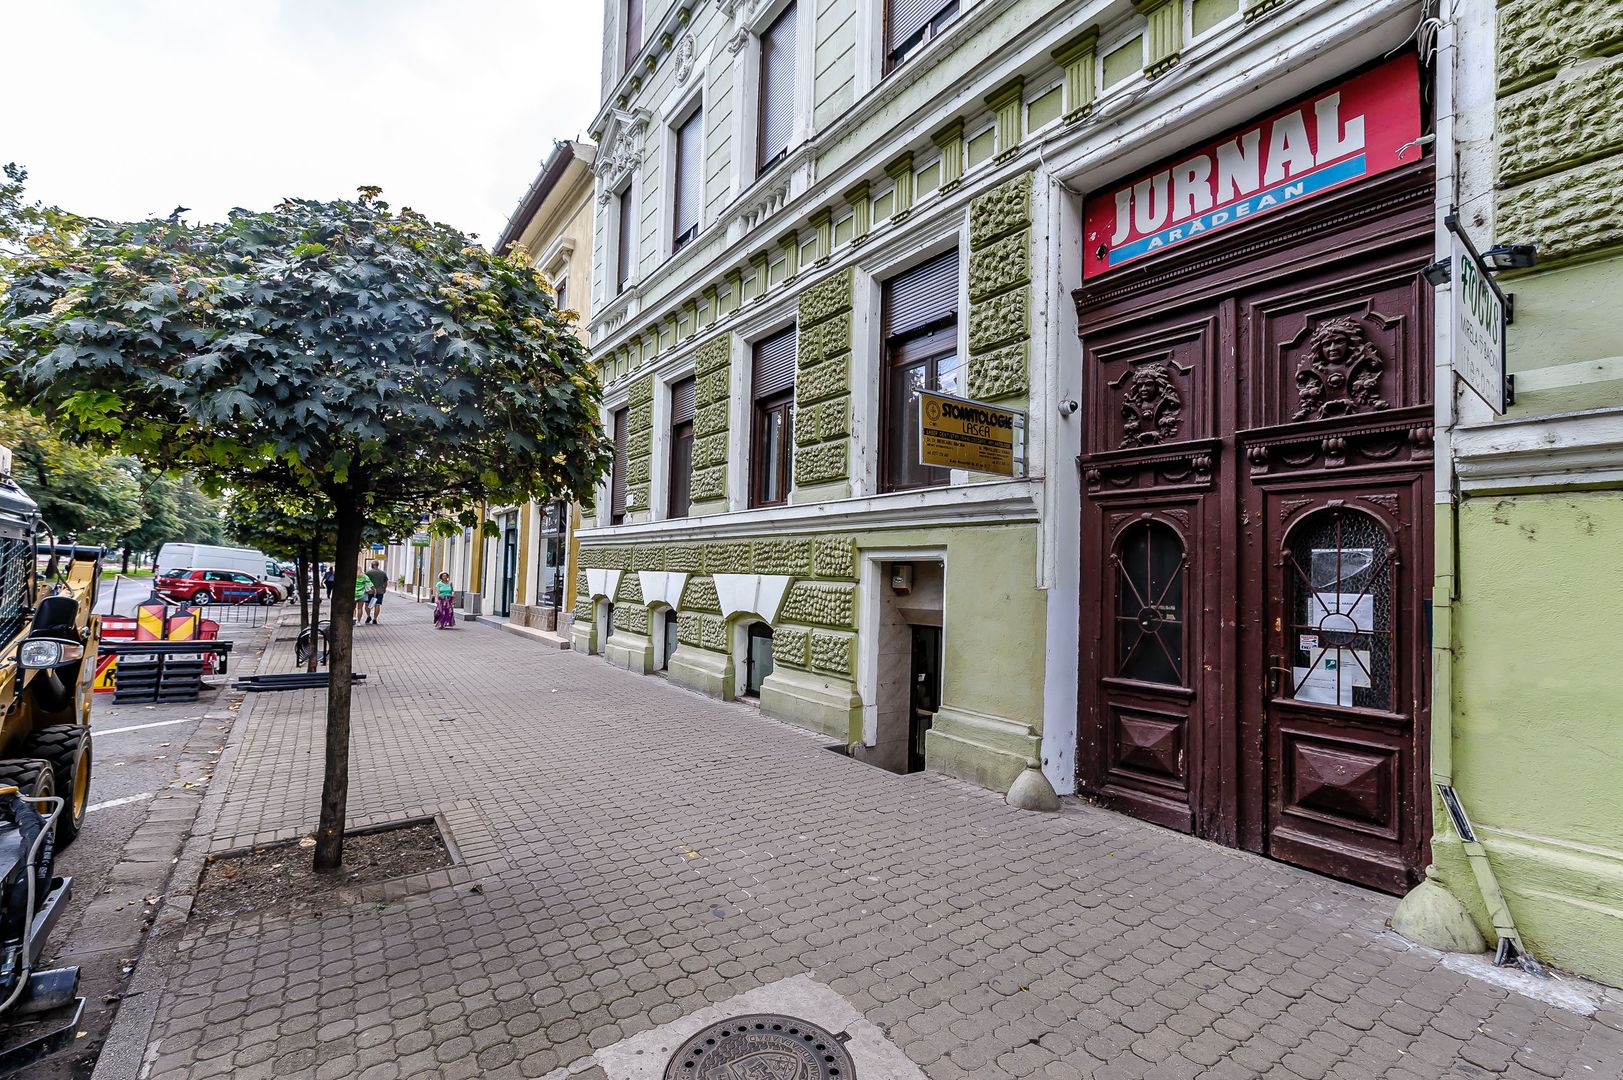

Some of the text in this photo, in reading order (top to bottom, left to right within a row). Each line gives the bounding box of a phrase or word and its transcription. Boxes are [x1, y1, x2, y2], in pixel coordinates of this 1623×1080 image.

[1111, 91, 1365, 246] JURNAL
[1147, 182, 1304, 251] ARĂDEAN
[1461, 254, 1499, 345] FOCUS
[942, 403, 1012, 430] STOMATOLOGIE
[962, 421, 991, 439] LASER
